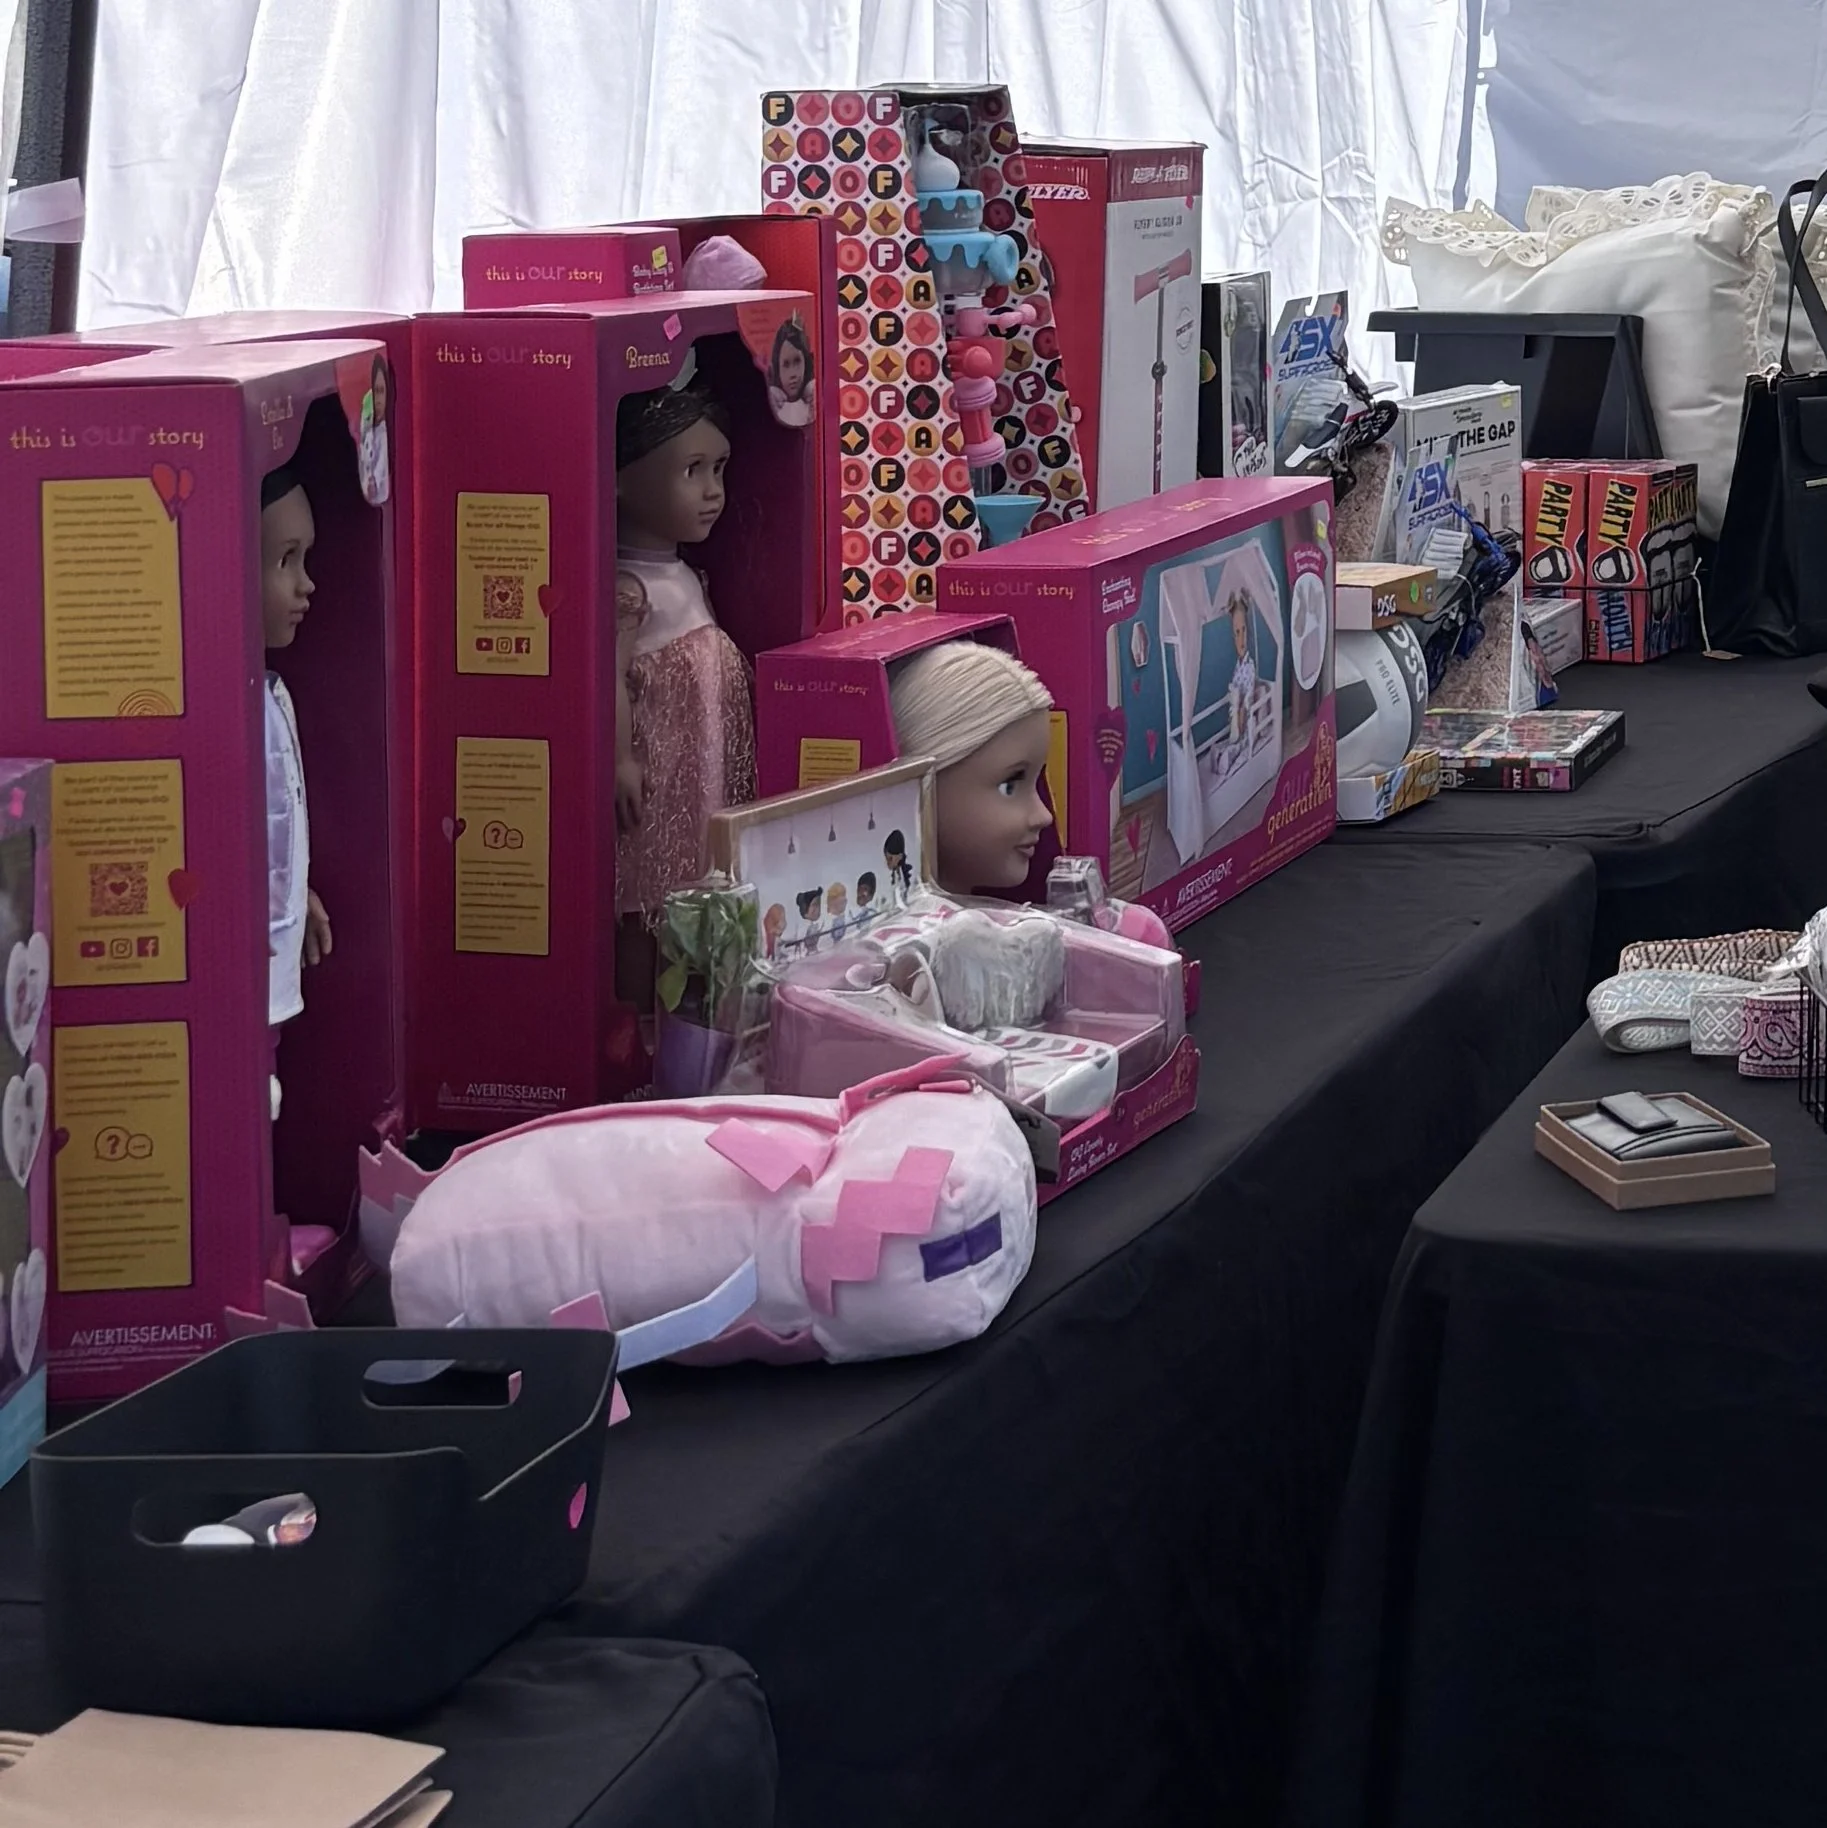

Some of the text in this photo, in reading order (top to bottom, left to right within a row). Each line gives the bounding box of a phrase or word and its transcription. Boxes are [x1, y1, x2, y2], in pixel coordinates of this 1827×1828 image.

[486, 266, 603, 284] this is our story
[436, 343, 572, 369] this is our story
[626, 345, 671, 369] Breena
[10, 425, 204, 450] this is our story
[1458, 427, 1485, 448] THE
[1488, 420, 1516, 441] GAP
[1535, 480, 1573, 546] PARTY
[1598, 480, 1638, 547] PARTY
[949, 580, 1074, 599] this is our story
[1377, 594, 1397, 617] DSG
[774, 679, 868, 696] this is our story
[1375, 659, 1400, 705] PRO ELITE
[1268, 782, 1334, 845] generation
[466, 1082, 567, 1100] AVERTISSEMENT
